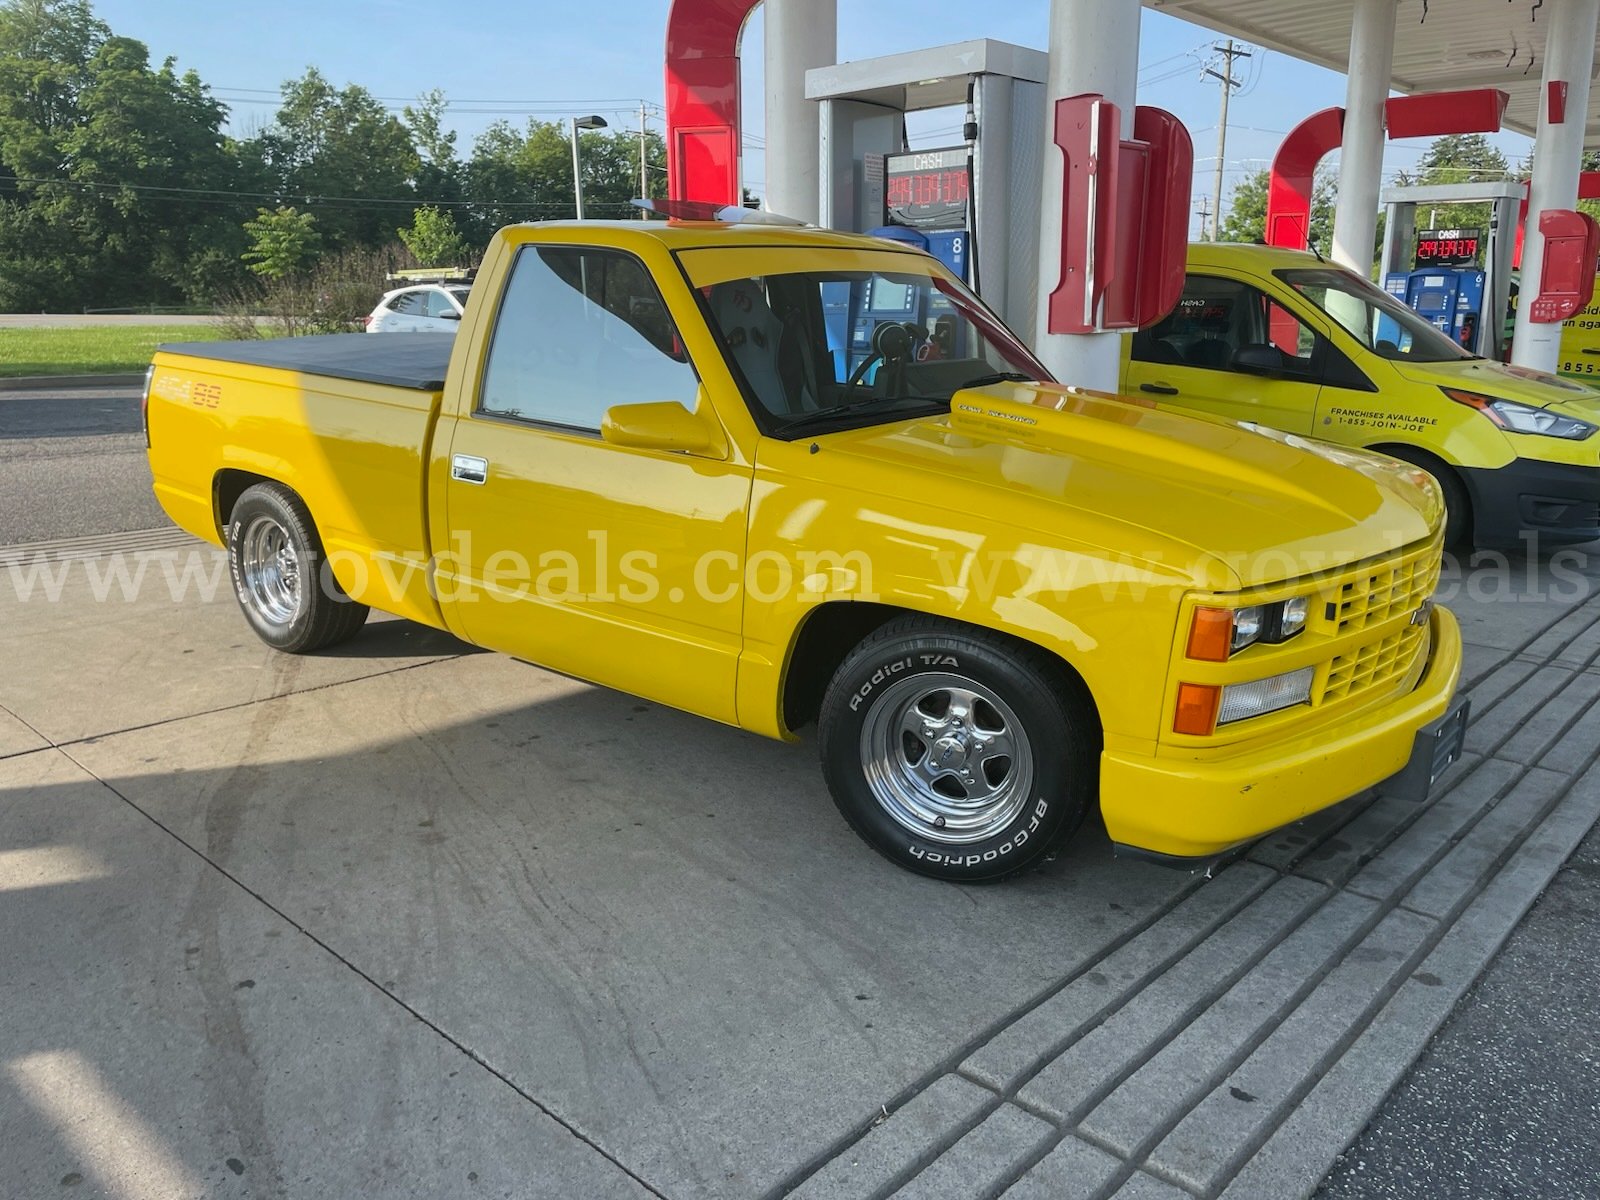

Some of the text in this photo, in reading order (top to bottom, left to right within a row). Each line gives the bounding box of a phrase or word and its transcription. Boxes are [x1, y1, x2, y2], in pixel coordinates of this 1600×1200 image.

[914, 153, 942, 170] CASH
[1438, 230, 1460, 239] CASH
[953, 238, 961, 253] 8
[1475, 275, 1482, 283] 6
[1331, 407, 1438, 426] FRANCHISES AVAILABLE
[1339, 417, 1424, 432] 1-855-JOIN-JOE
[850, 655, 959, 711] Radial T/A
[908, 798, 1048, 868] BFGoodrich
